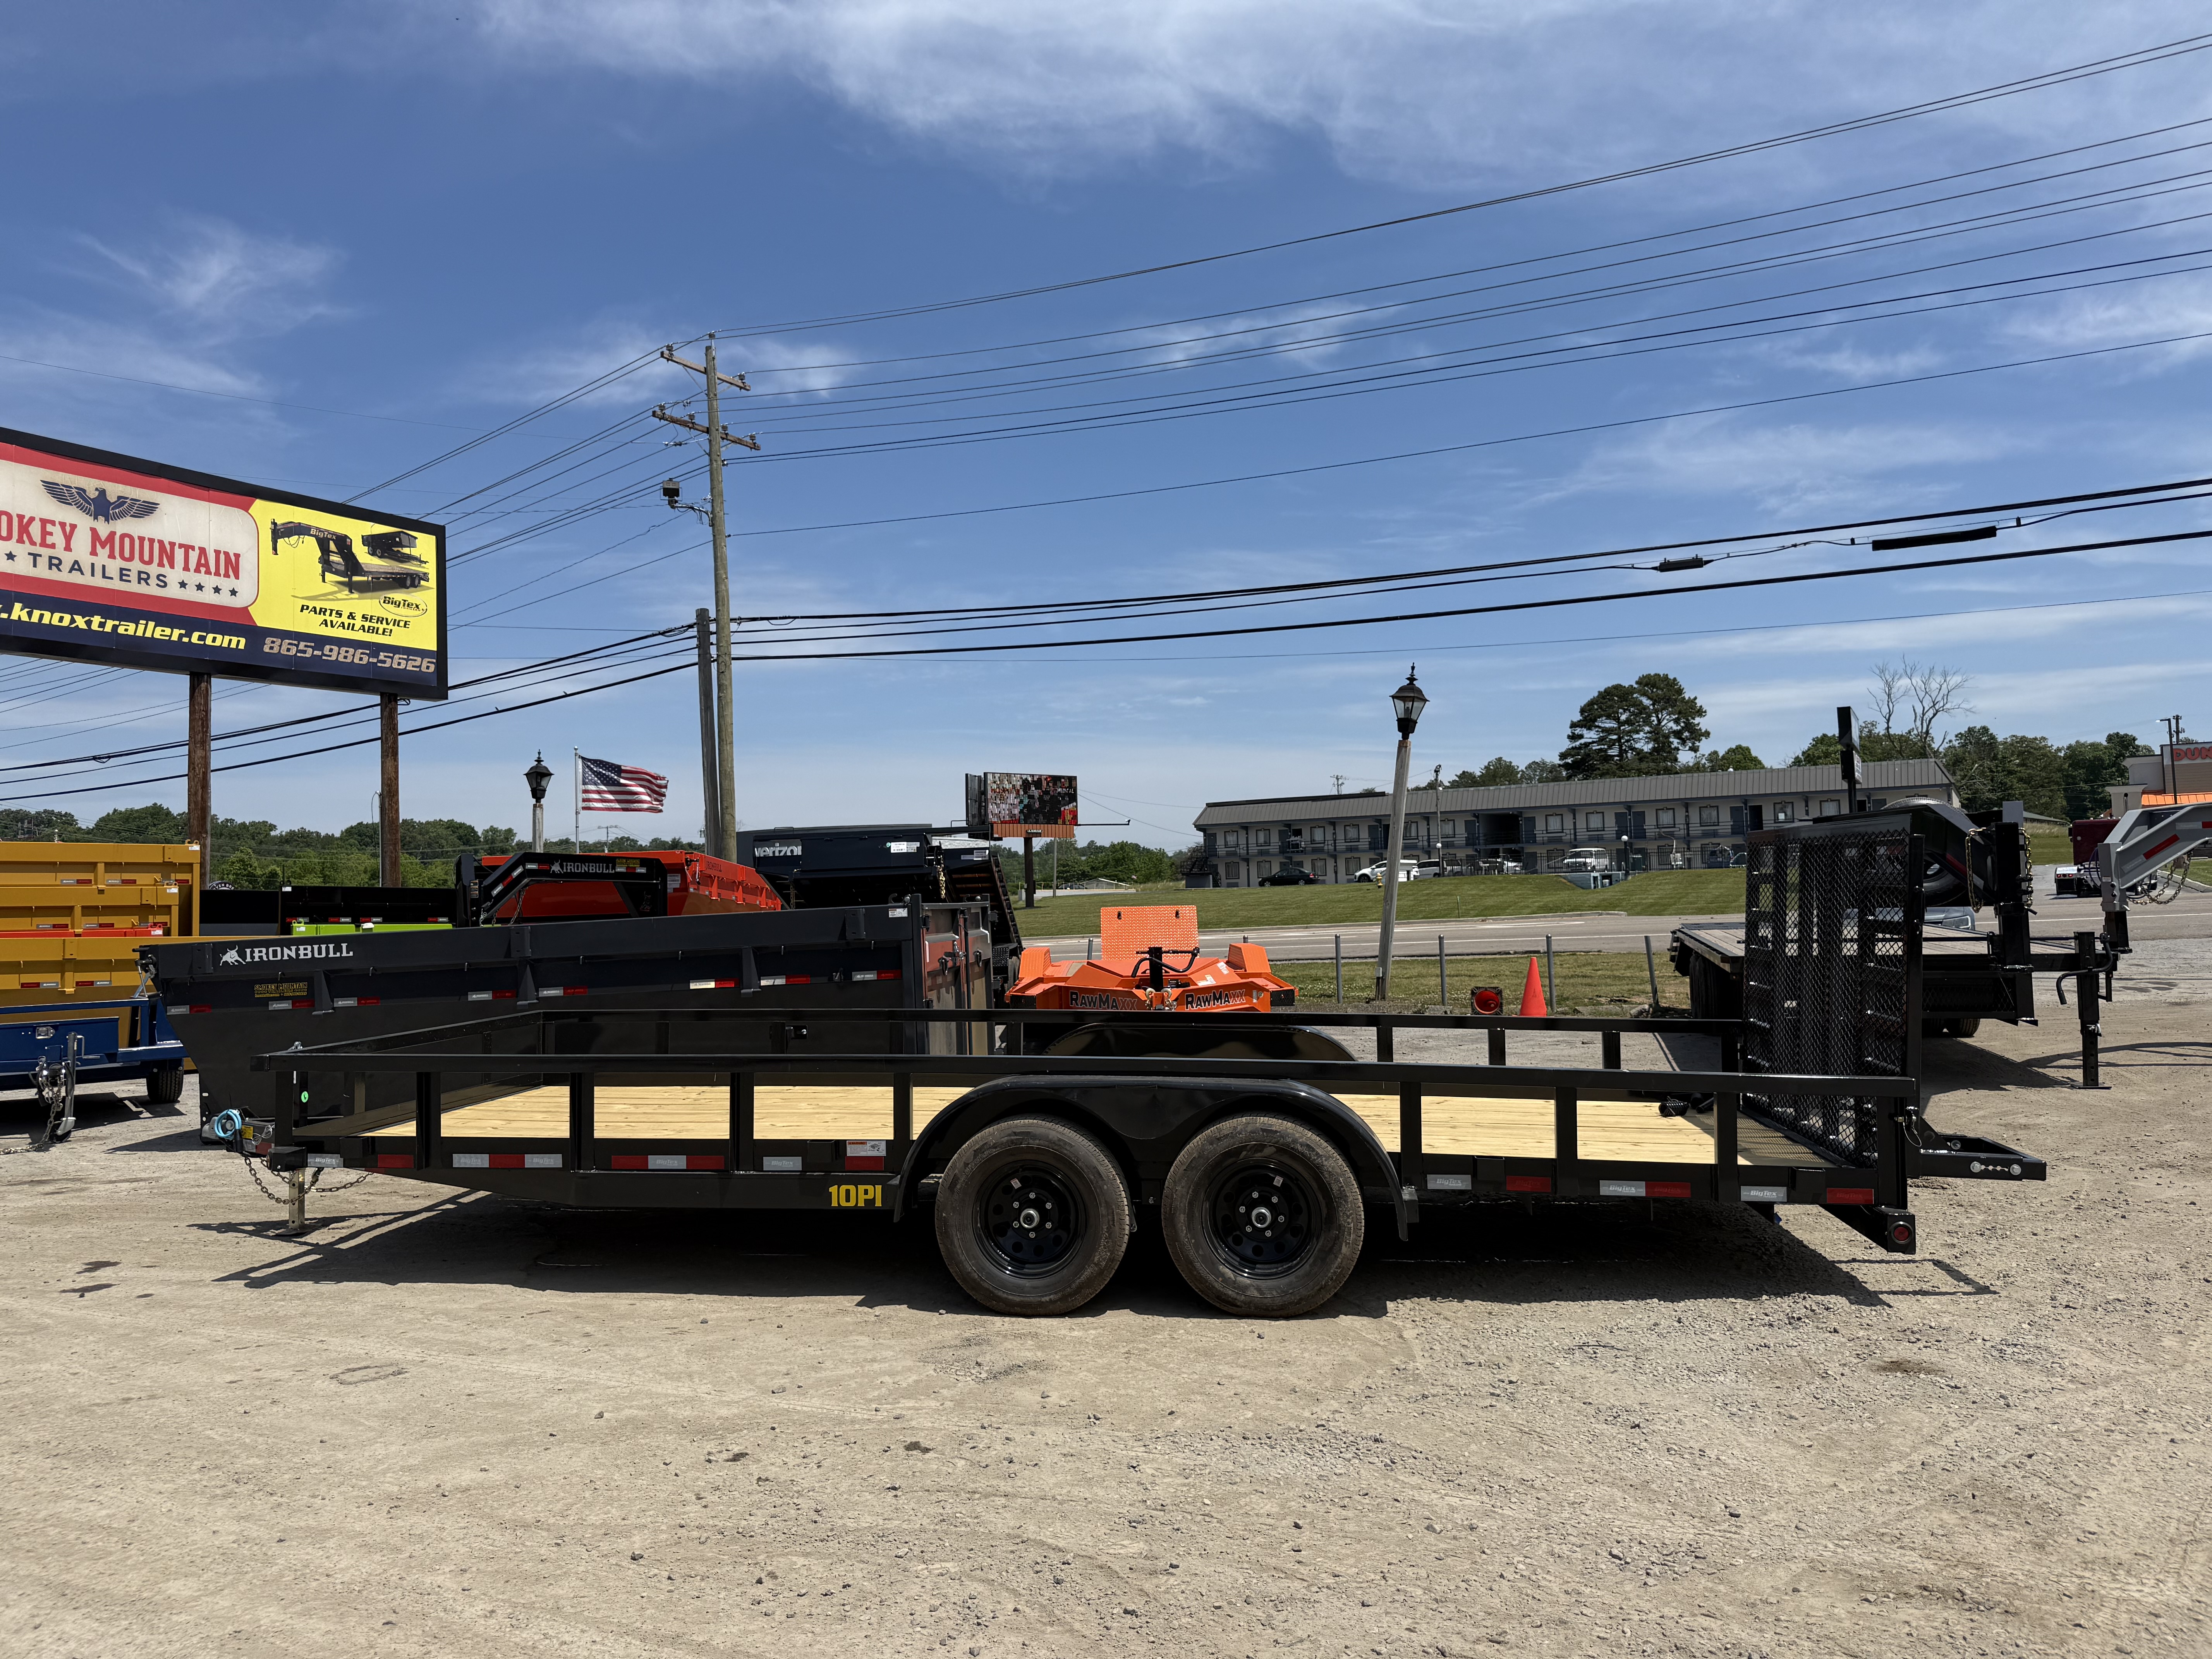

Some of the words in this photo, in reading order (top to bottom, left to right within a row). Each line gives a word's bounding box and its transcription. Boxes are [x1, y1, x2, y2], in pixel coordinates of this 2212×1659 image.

[310, 529, 337, 539] BigTex
[0, 510, 77, 552] OKEY
[89, 527, 240, 580] MOUNTAIN
[27, 552, 168, 588] TRAILERS
[383, 596, 421, 610] BigTex
[0, 602, 246, 649] .knoxtrailer.com
[300, 605, 343, 618] PARTS
[347, 612, 356, 620] &
[361, 613, 410, 629] SERVICE
[319, 618, 393, 637] AVAILABLE!
[263, 637, 436, 673] 865-986-5626
[563, 862, 615, 873] IRONBULL
[245, 943, 353, 962] IRONBULL
[829, 1185, 882, 1206] 10PI
